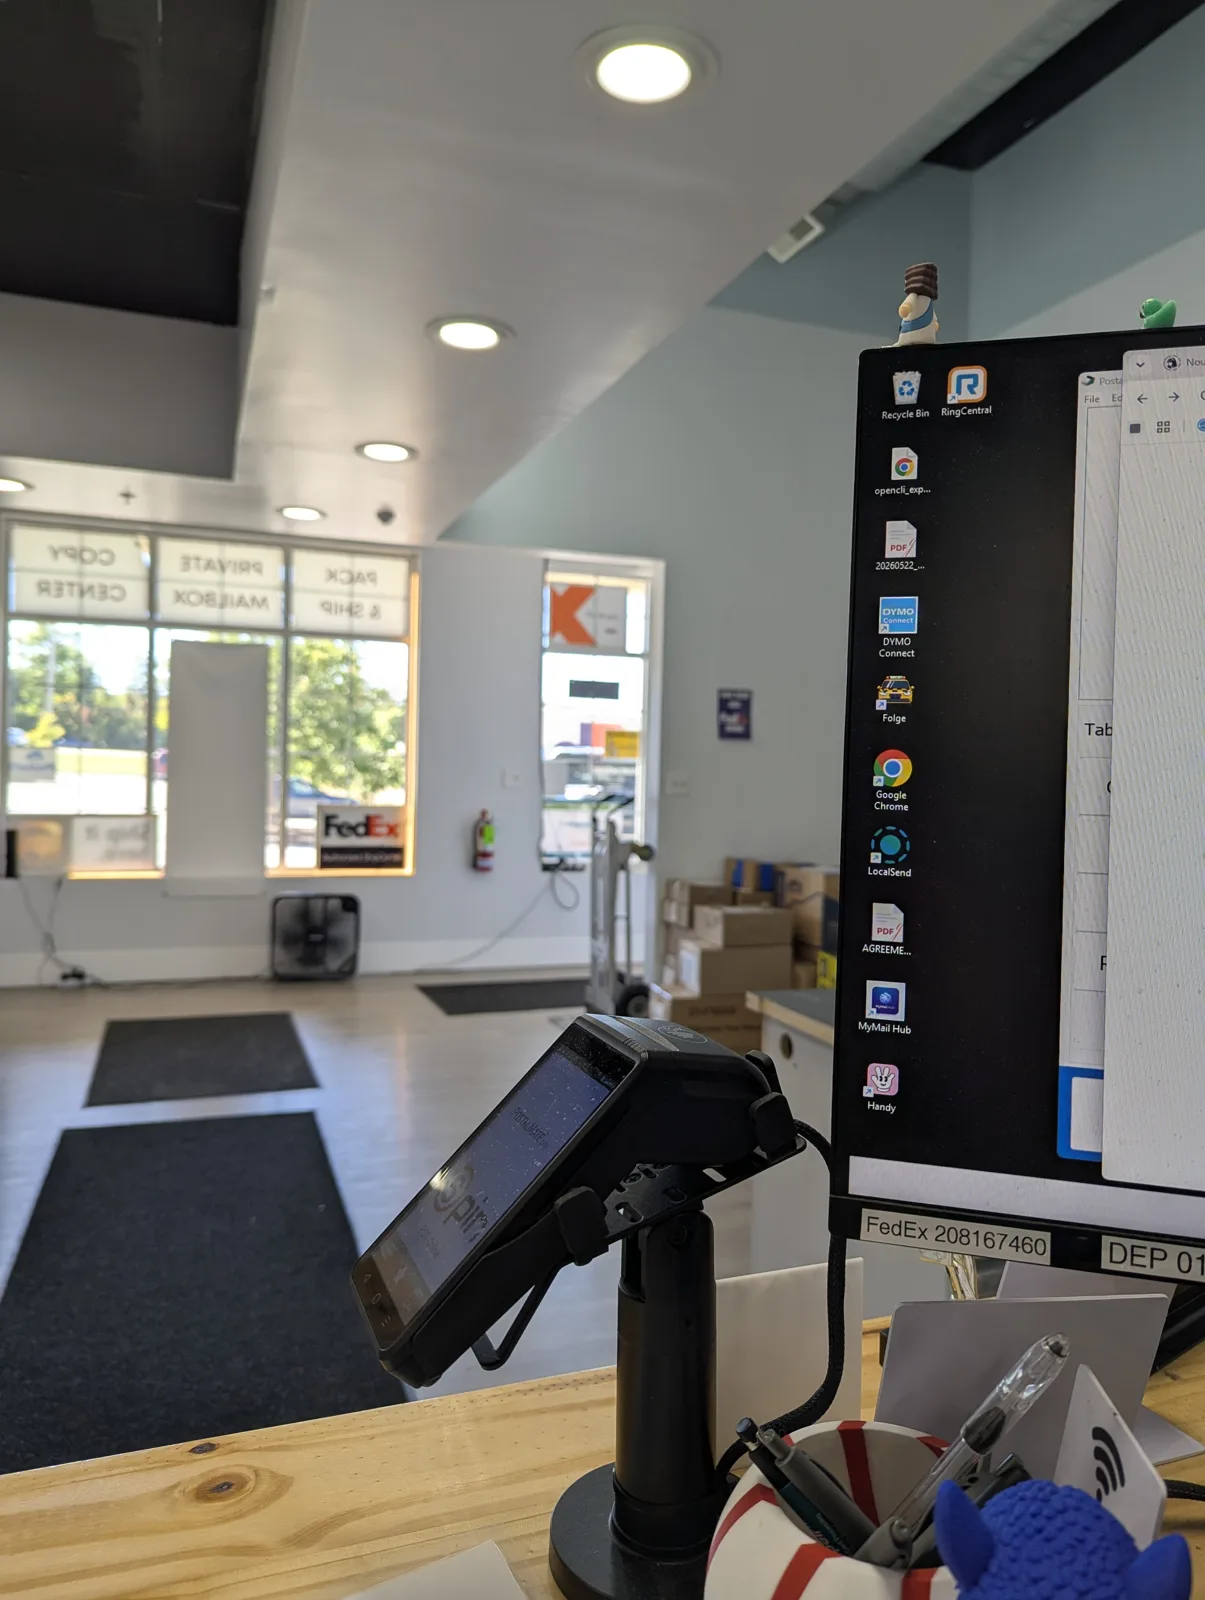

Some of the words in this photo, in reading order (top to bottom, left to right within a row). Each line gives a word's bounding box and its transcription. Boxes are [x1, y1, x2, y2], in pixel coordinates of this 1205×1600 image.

[1084, 394, 1100, 403] File
[881, 410, 914, 420] Recycle
[916, 408, 930, 418] Bin
[941, 405, 992, 417] RingCentral
[890, 544, 908, 552] PDF
[875, 561, 925, 570] 20260522_...
[882, 608, 914, 616] DYMO
[883, 637, 911, 646] DYMO
[878, 649, 915, 658] Connect
[882, 713, 906, 725] Folge
[875, 790, 907, 801] Google
[873, 801, 909, 811] Chrome
[324, 814, 400, 838] FedEx
[867, 866, 912, 877] LocalSend
[876, 927, 894, 935] PDF
[862, 943, 912, 956] AGREEME...
[858, 1021, 890, 1033] MyMail
[892, 1024, 912, 1035] Hub
[867, 1100, 896, 1114] Handy
[866, 1215, 928, 1241] FedEx
[934, 1224, 1047, 1257] 208167460
[1109, 1241, 1167, 1269] DEP
[1176, 1251, 1205, 1276] 01
